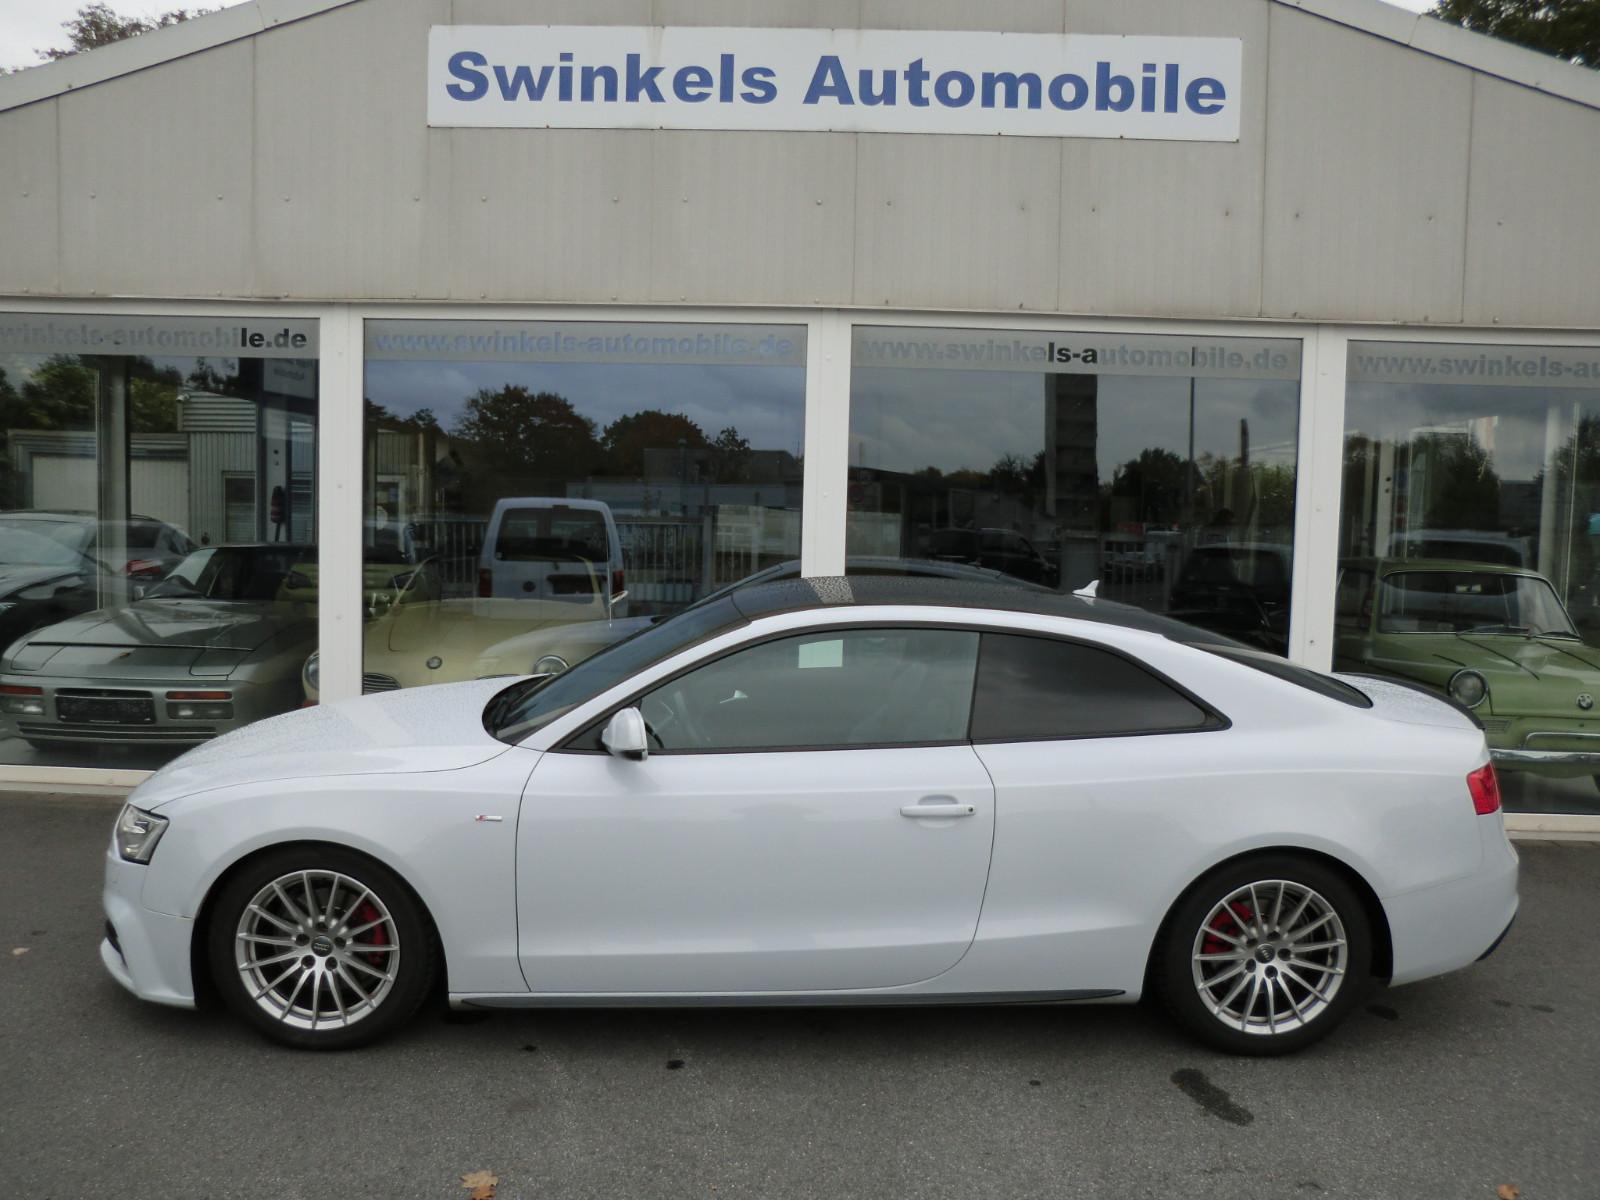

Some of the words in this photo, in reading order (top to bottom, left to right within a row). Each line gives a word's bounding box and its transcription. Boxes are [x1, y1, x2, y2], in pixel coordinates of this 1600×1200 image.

[447, 51, 777, 103] Swinkels
[804, 55, 1226, 114] Automobile
[374, 329, 793, 357] www.swinkels-automobile.de
[861, 337, 1289, 371] www.swinkels-automobile.de
